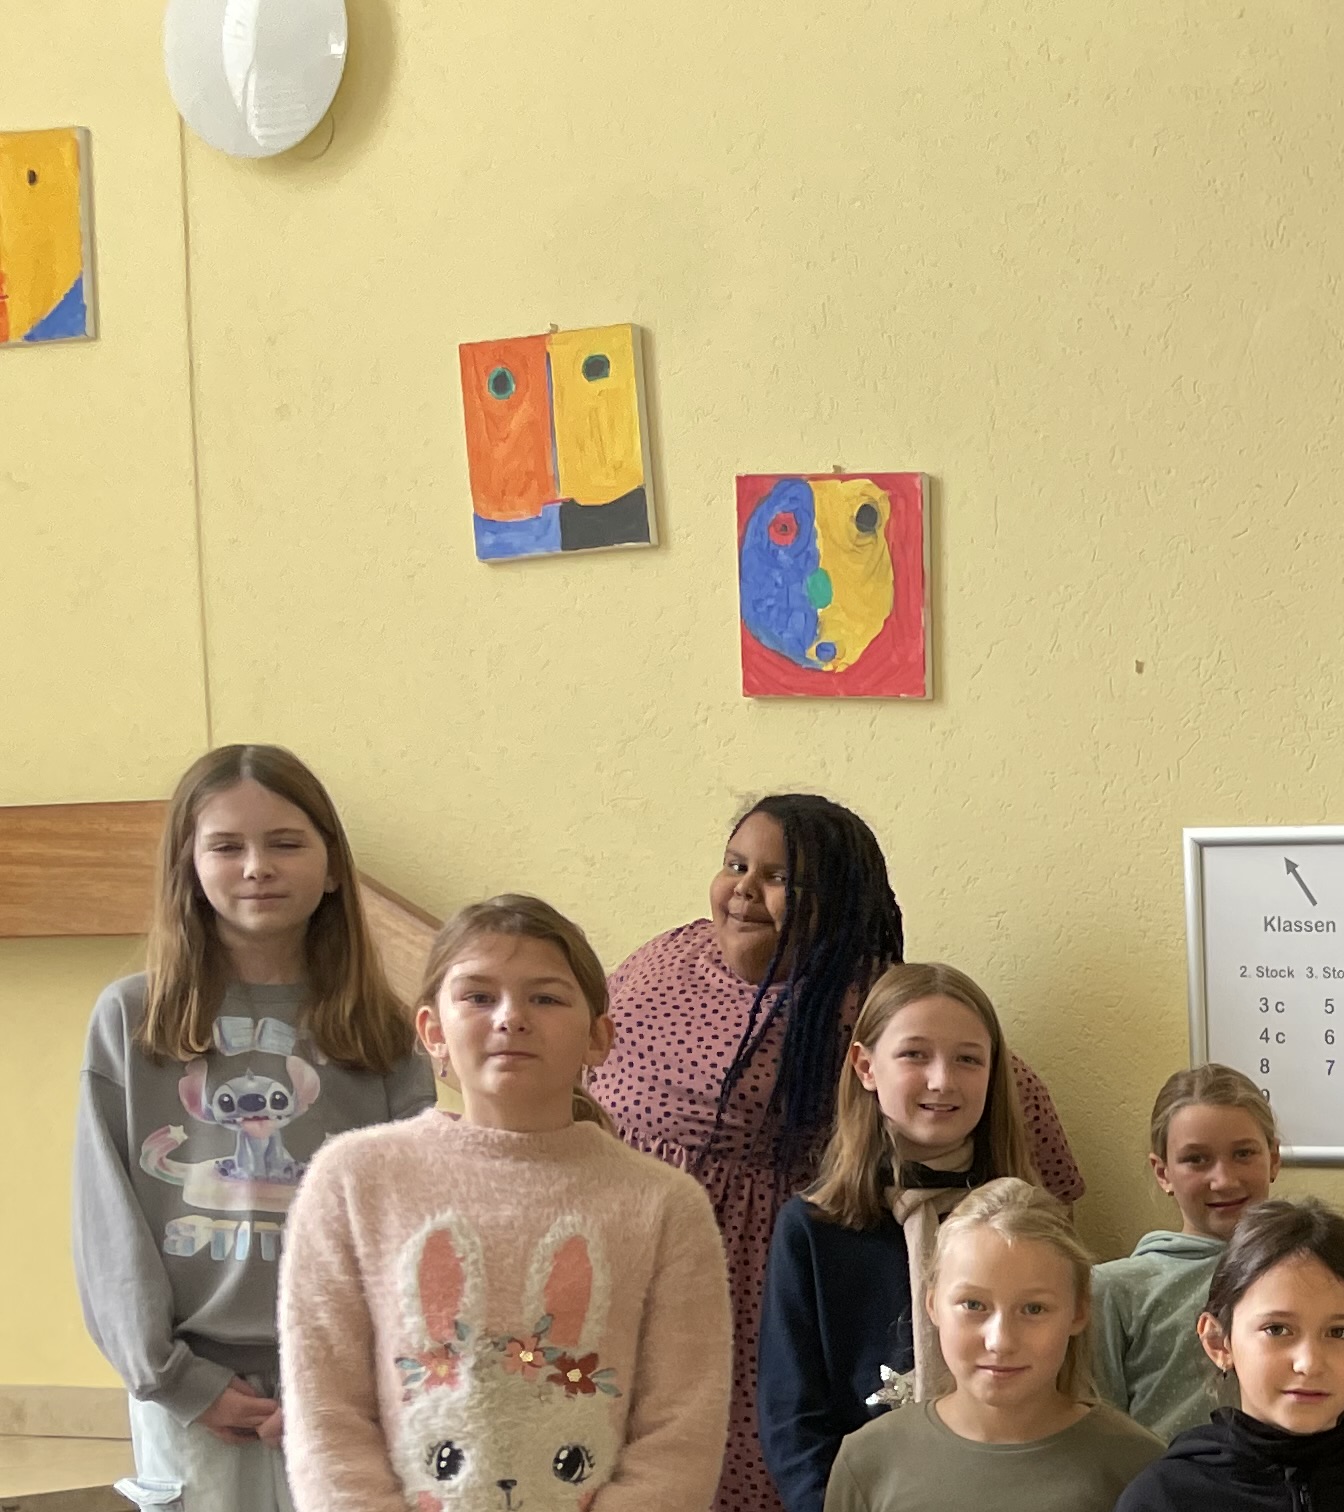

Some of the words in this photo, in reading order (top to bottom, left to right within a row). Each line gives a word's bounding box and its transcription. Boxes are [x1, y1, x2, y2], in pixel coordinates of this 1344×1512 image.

[1263, 915, 1336, 933] Klassen
[1239, 965, 1252, 979] 2.
[1255, 965, 1295, 979] Stock
[1305, 966, 1318, 980] 3.
[1258, 997, 1270, 1014] 3
[1275, 1000, 1286, 1014] c
[1323, 998, 1336, 1015] 5
[1258, 1027, 1271, 1044] 4
[1275, 1031, 1286, 1044] c
[1324, 1029, 1336, 1046] 6
[1259, 1058, 1271, 1075] 8
[1325, 1059, 1336, 1076] 7
